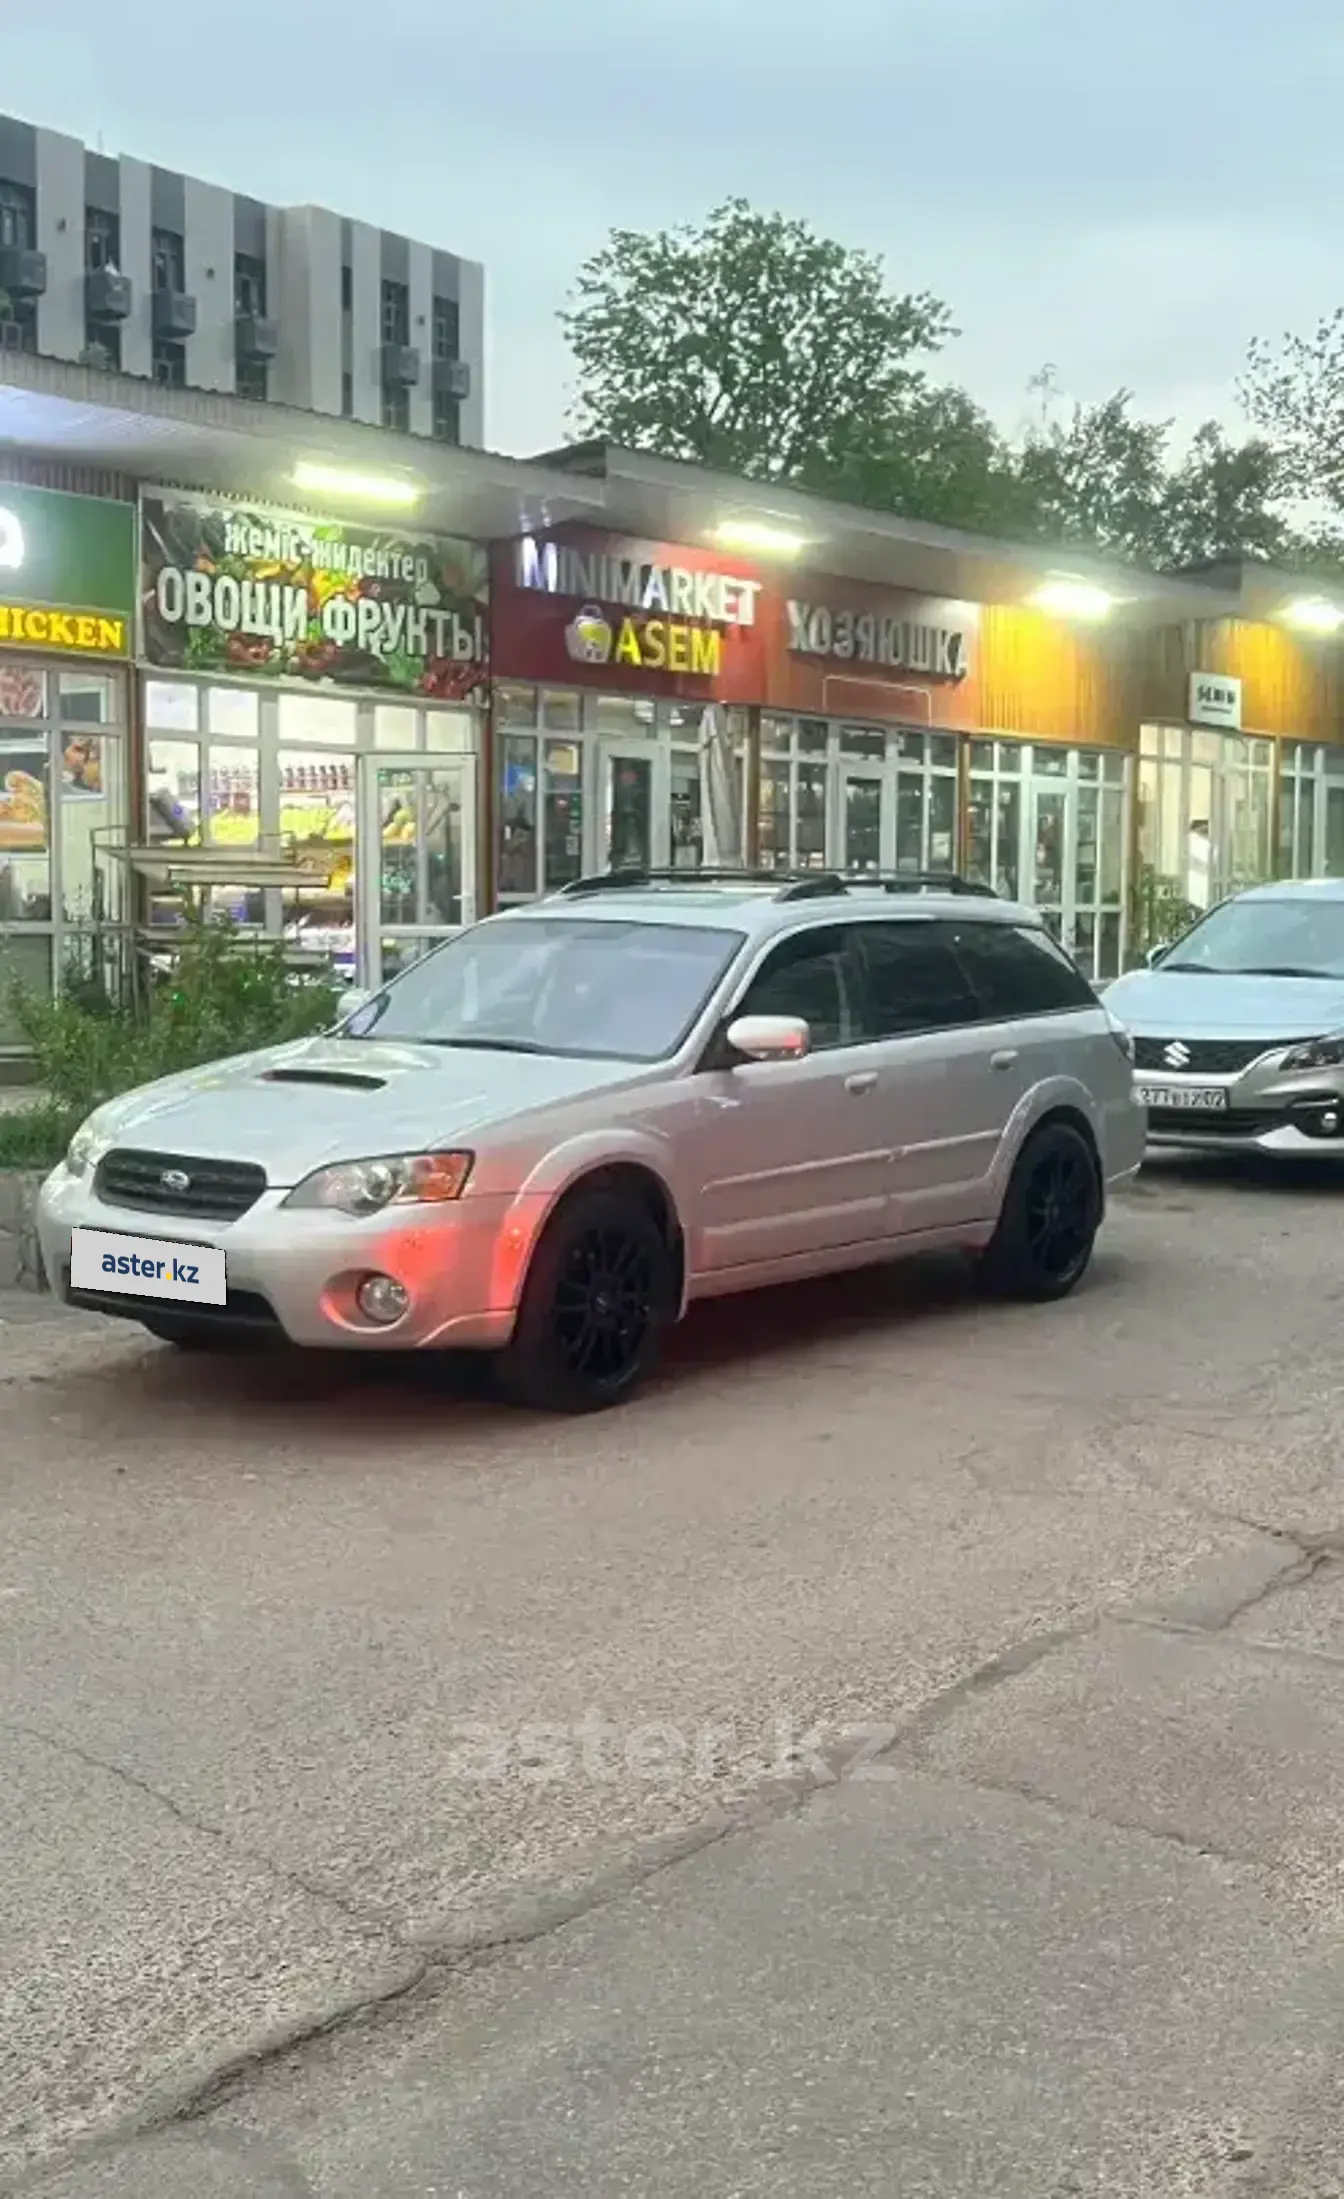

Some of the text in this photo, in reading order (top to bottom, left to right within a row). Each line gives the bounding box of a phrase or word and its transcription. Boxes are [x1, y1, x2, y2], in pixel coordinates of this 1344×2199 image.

[157, 567, 482, 662] ОВОЩИ ФРУКТЫ
[516, 536, 761, 626] MINIMARKET
[616, 617, 720, 676] ASEM
[786, 599, 968, 678] ХОЗЯЮШКА
